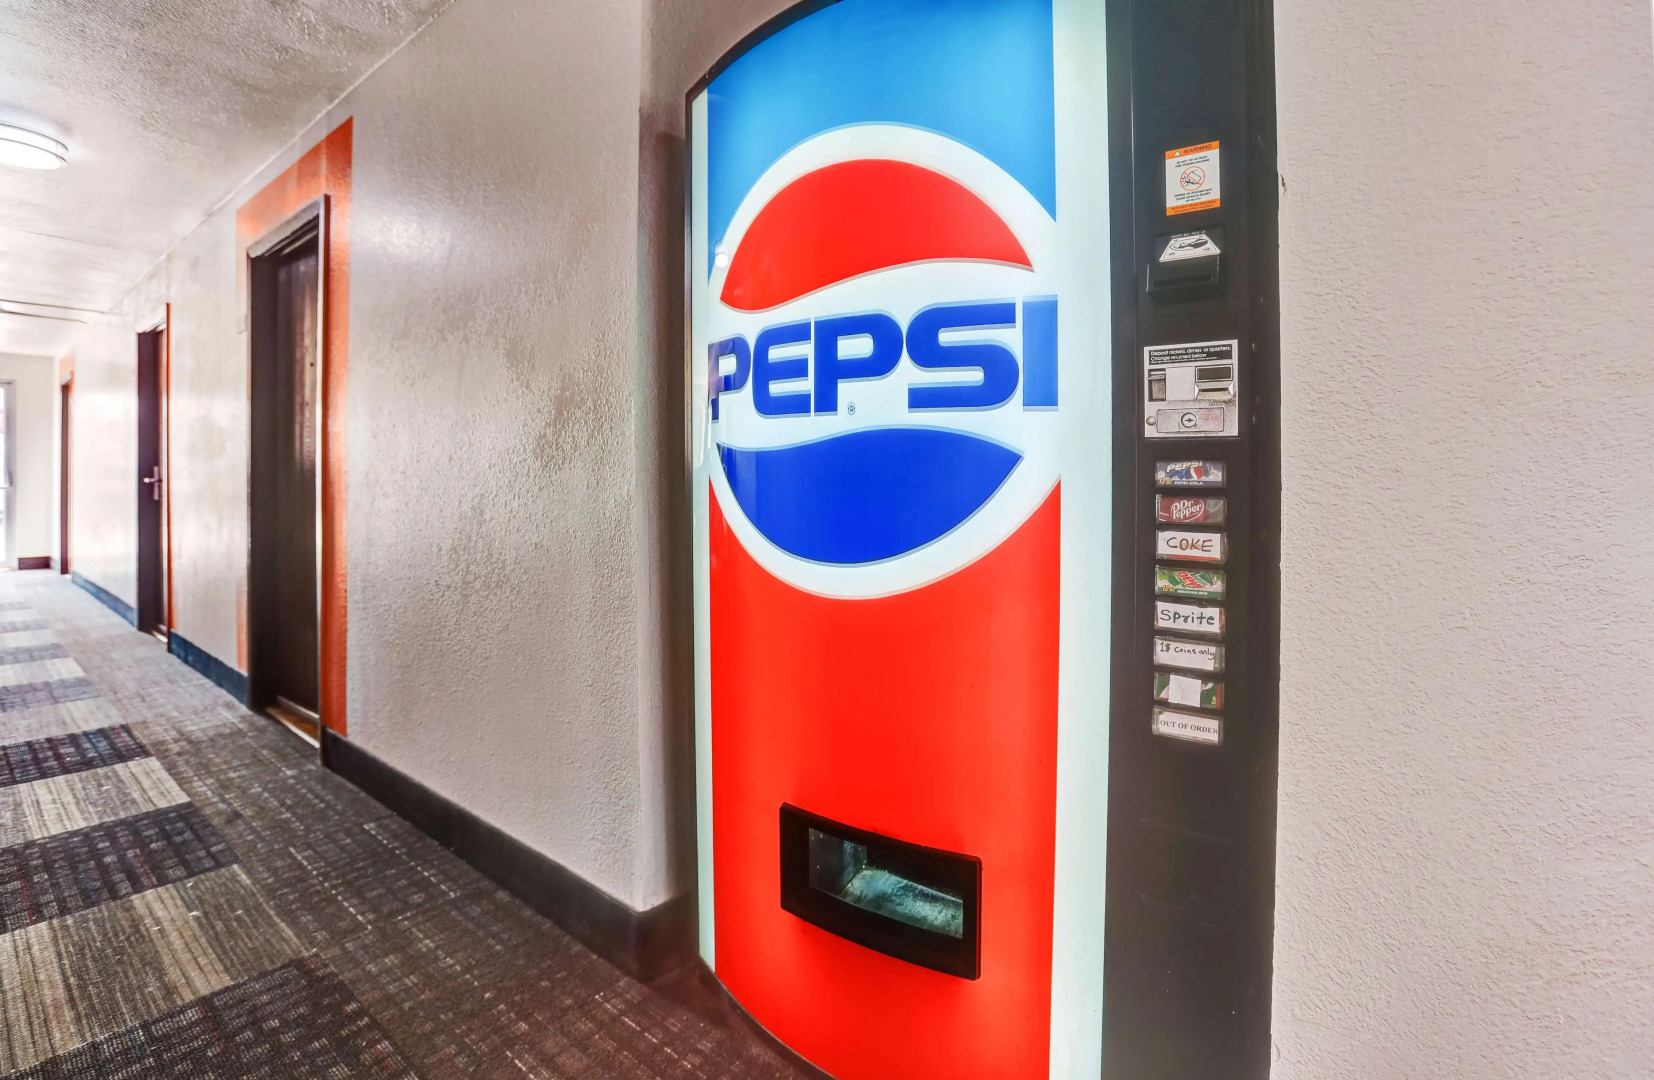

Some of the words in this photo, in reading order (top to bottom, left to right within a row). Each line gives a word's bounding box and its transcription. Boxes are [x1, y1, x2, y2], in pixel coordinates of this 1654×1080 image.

[1183, 144, 1212, 154] WARNING
[707, 295, 1058, 424] PEPSI
[1167, 460, 1203, 472] PEPSI
[1171, 503, 1202, 519] Pepper
[1180, 500, 1194, 510] Dr
[1166, 536, 1214, 553] COKE
[1199, 647, 1216, 660] only
[1160, 719, 1176, 728] OUT
[1178, 722, 1189, 730] OF
[1190, 724, 1218, 735] ORDER
